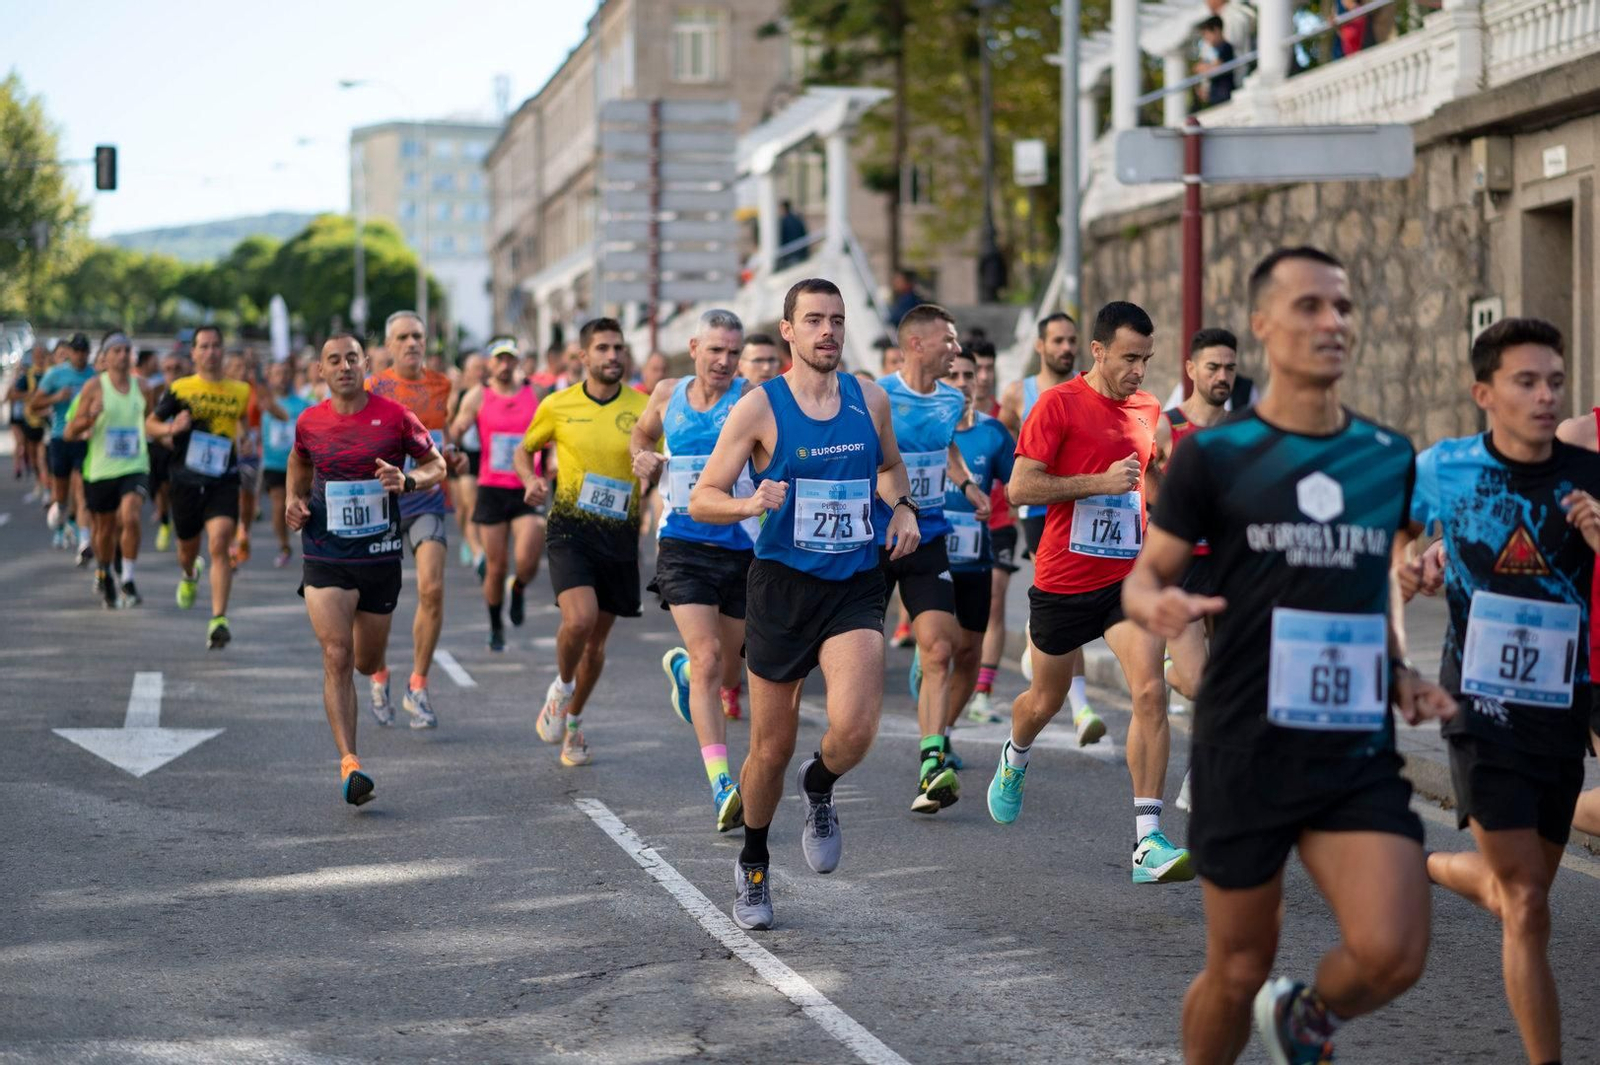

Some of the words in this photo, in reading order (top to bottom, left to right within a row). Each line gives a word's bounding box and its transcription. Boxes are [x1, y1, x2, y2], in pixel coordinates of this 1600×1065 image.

[811, 443, 865, 457] EUROSPORT
[343, 506, 370, 526] 601
[813, 512, 853, 539] 273
[1091, 518, 1122, 545] 174
[1499, 643, 1539, 683] 92
[1310, 665, 1351, 706] 69
